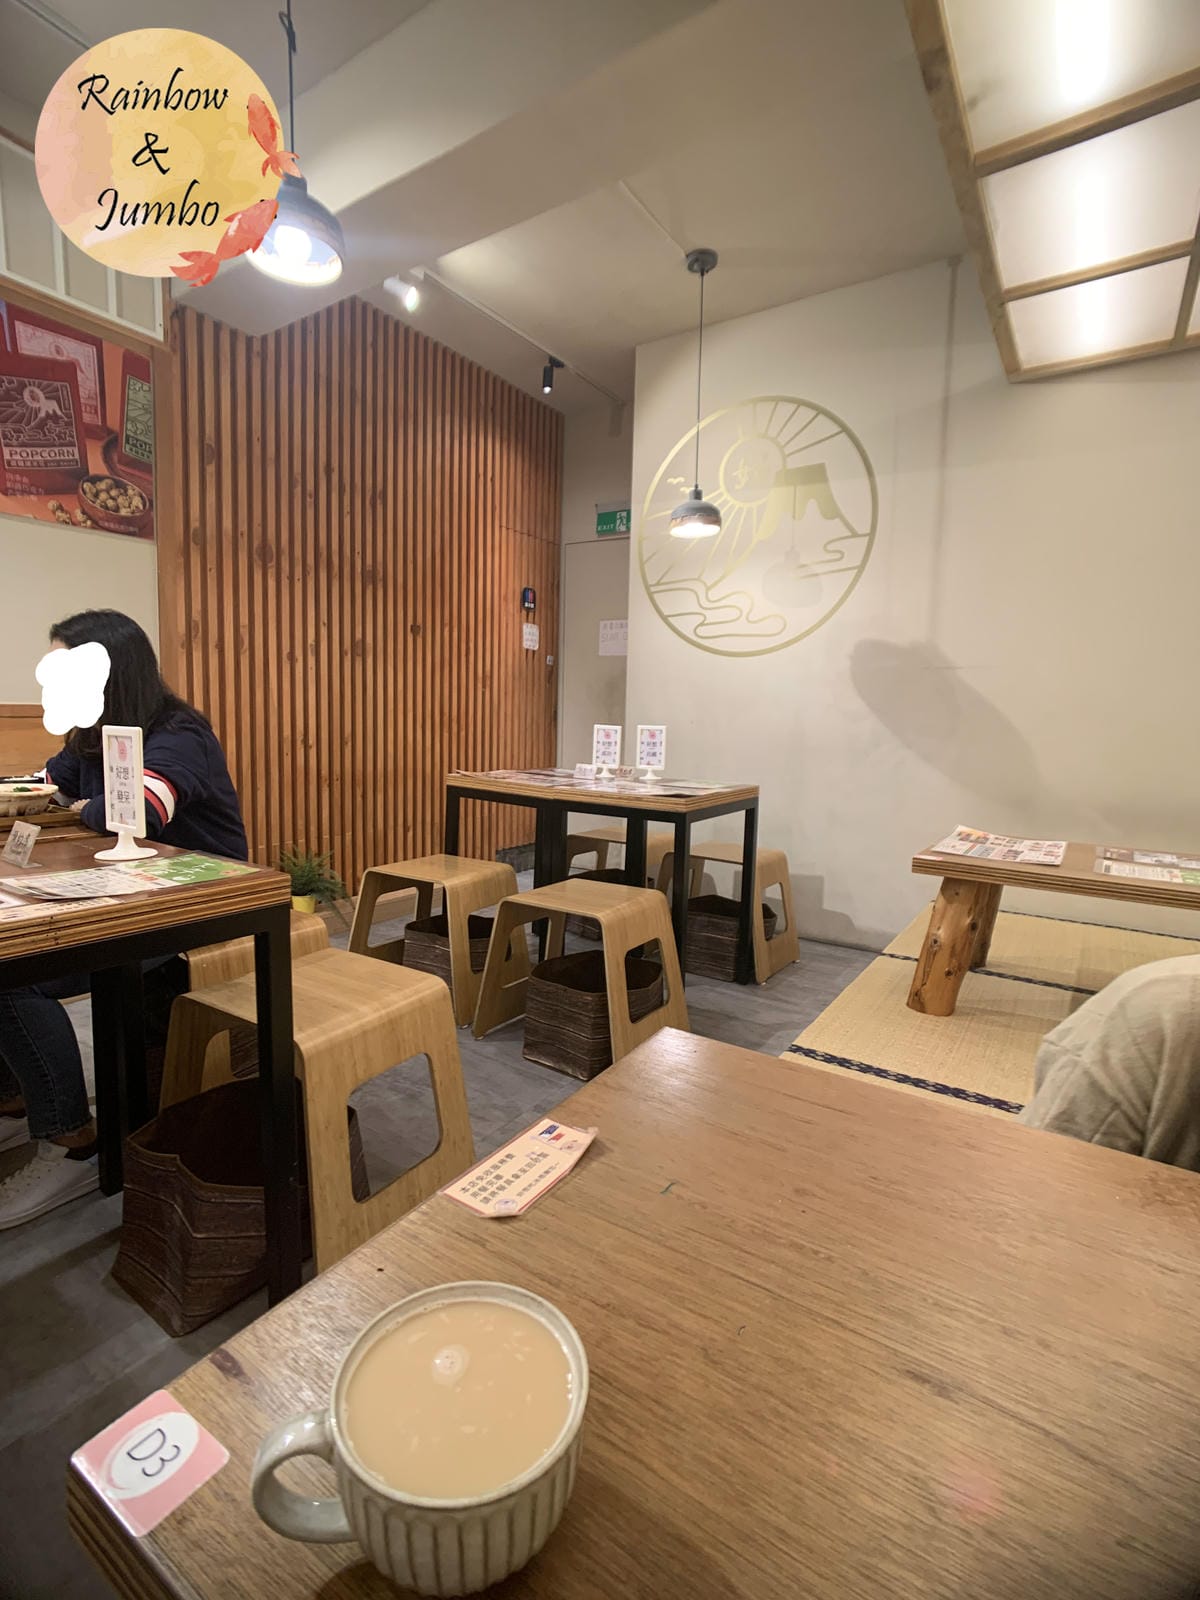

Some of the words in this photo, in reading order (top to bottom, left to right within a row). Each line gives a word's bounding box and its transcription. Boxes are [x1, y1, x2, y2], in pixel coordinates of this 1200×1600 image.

[8, 448, 76, 459] POPCORN
[597, 523, 614, 531] EXIT
[126, 1428, 181, 1477] D3
